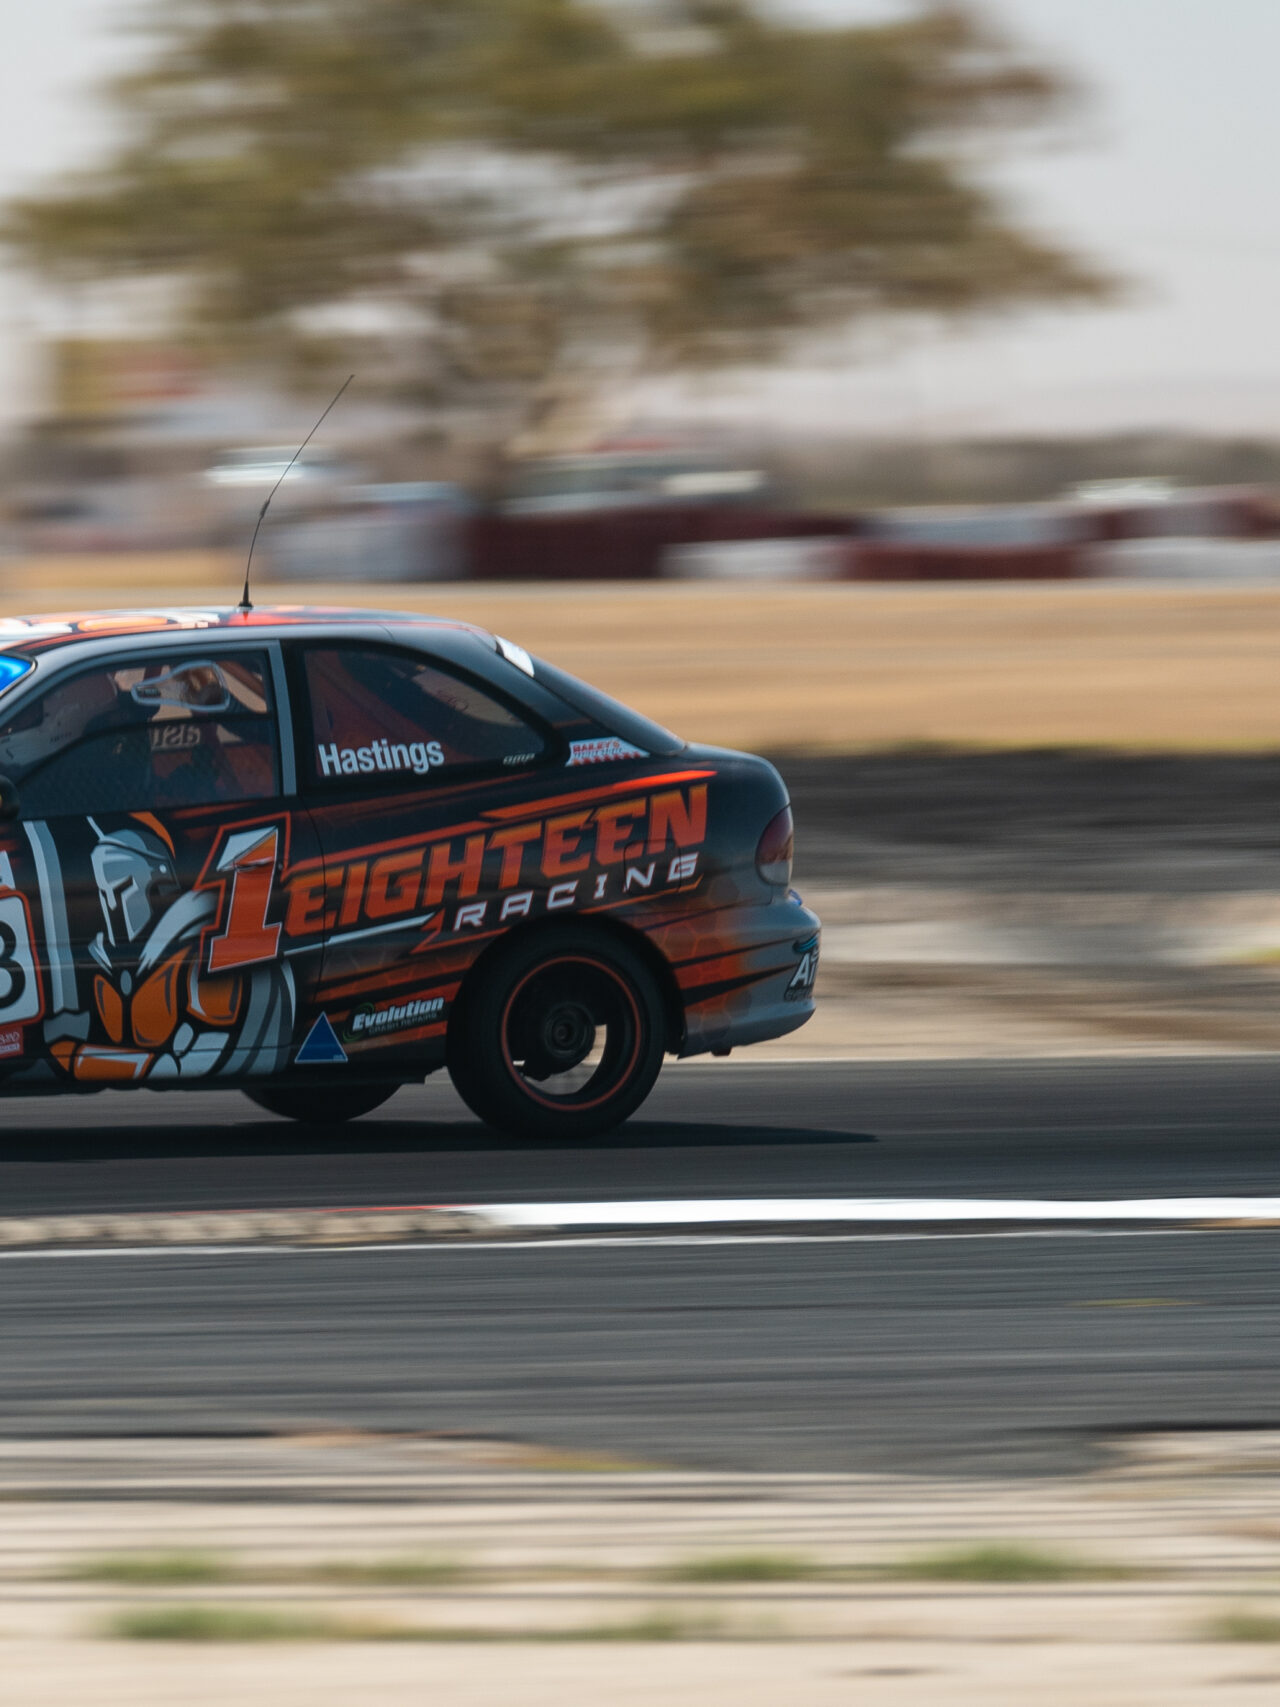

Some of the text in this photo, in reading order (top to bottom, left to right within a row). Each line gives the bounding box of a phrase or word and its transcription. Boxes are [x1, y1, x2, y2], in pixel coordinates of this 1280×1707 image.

[318, 738, 445, 777] Hastings
[284, 783, 709, 938] EIGHTEEN
[453, 852, 700, 931] RACING
[352, 997, 445, 1031] Evolution
